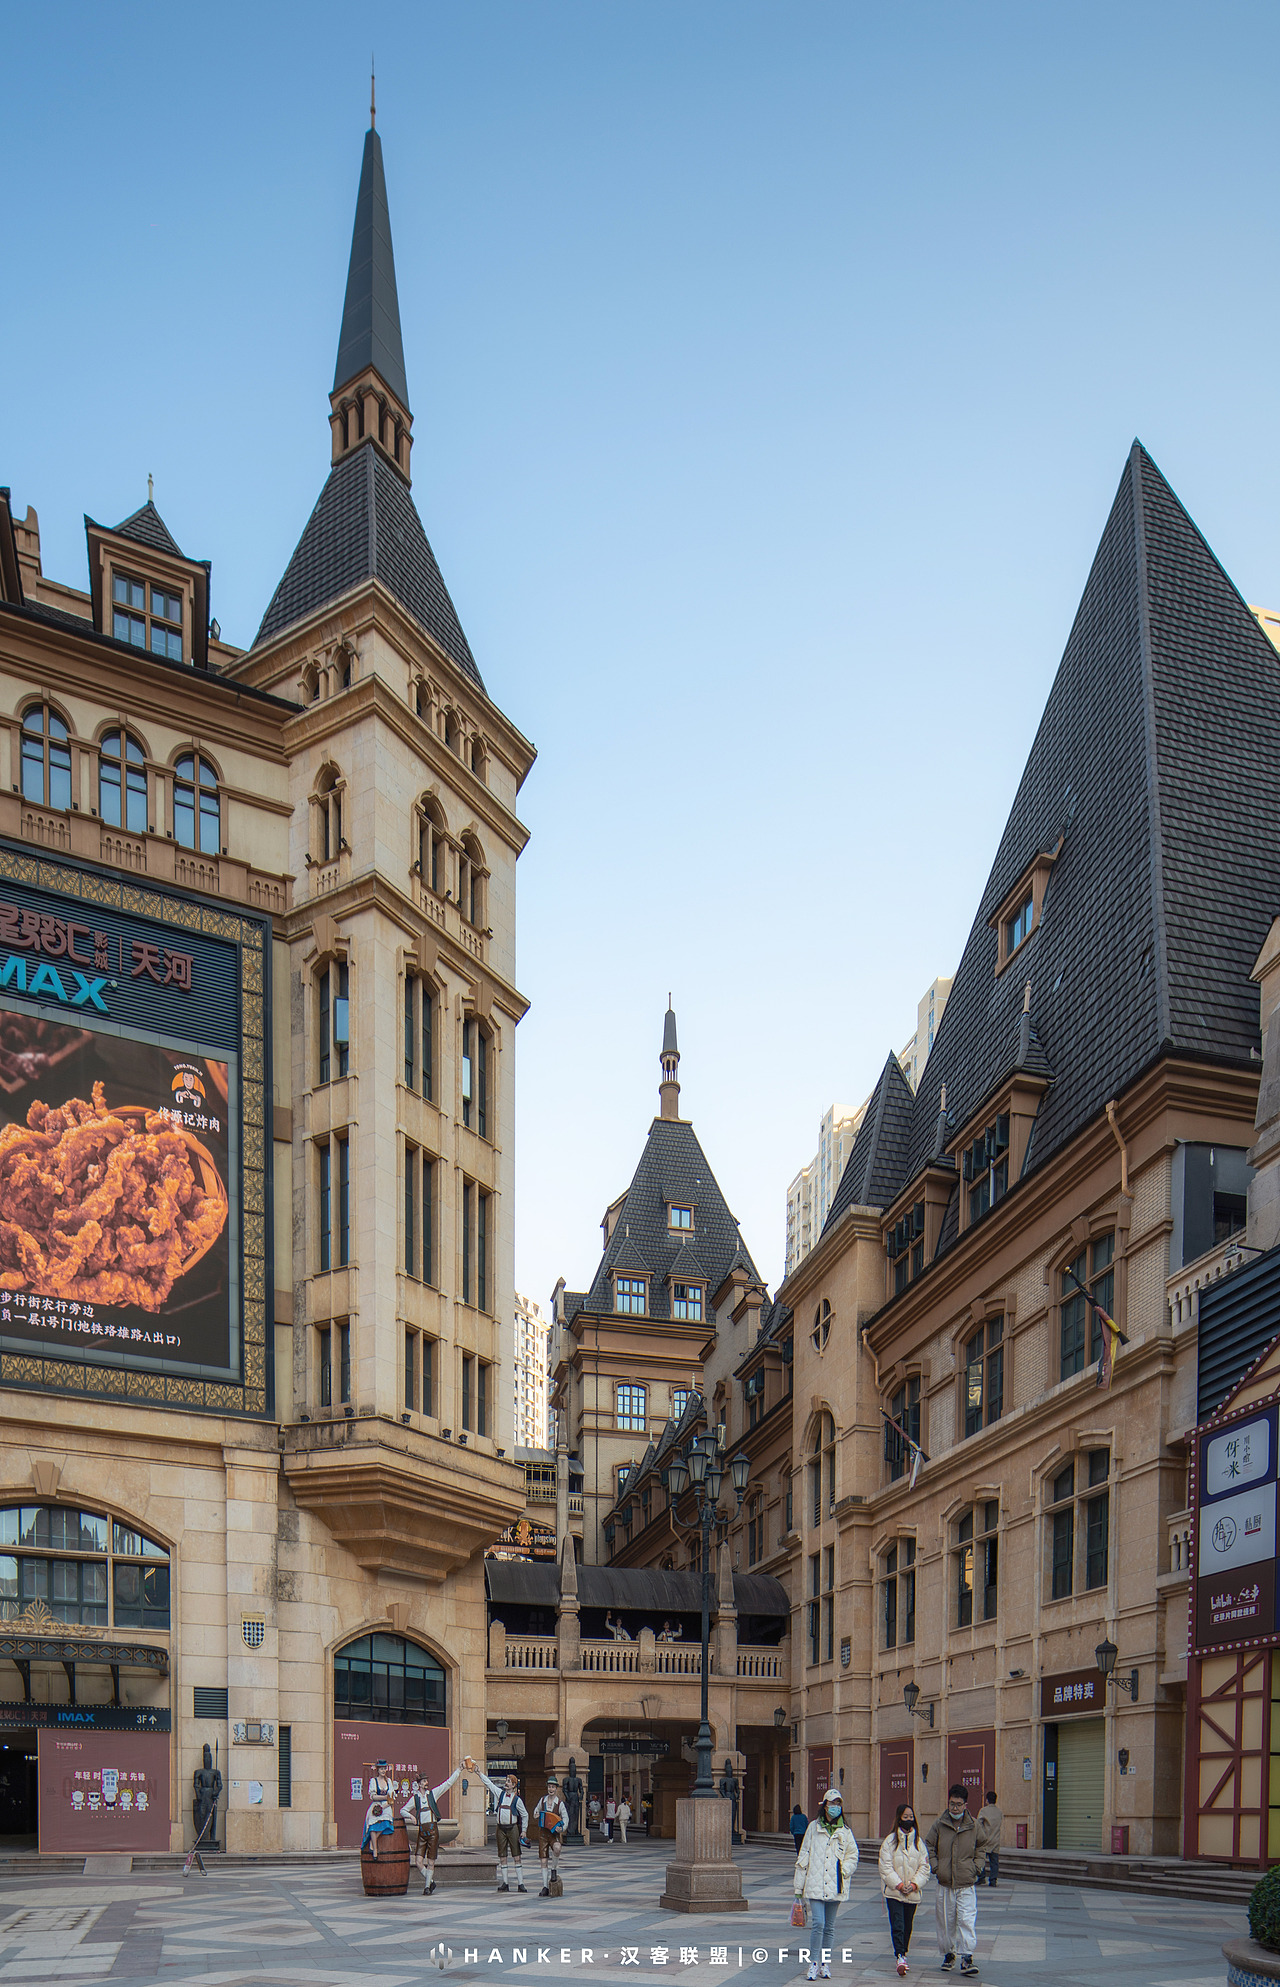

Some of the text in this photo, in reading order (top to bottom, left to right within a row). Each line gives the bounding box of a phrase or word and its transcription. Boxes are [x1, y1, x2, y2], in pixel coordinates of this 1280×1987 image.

[131, 940, 194, 993] 天河
[0, 1291, 95, 1318] 步行街农行旁边
[1053, 1682, 1094, 1703] 品牌特卖
[57, 1712, 95, 1723] IMAX
[136, 1714, 147, 1724] 3F
